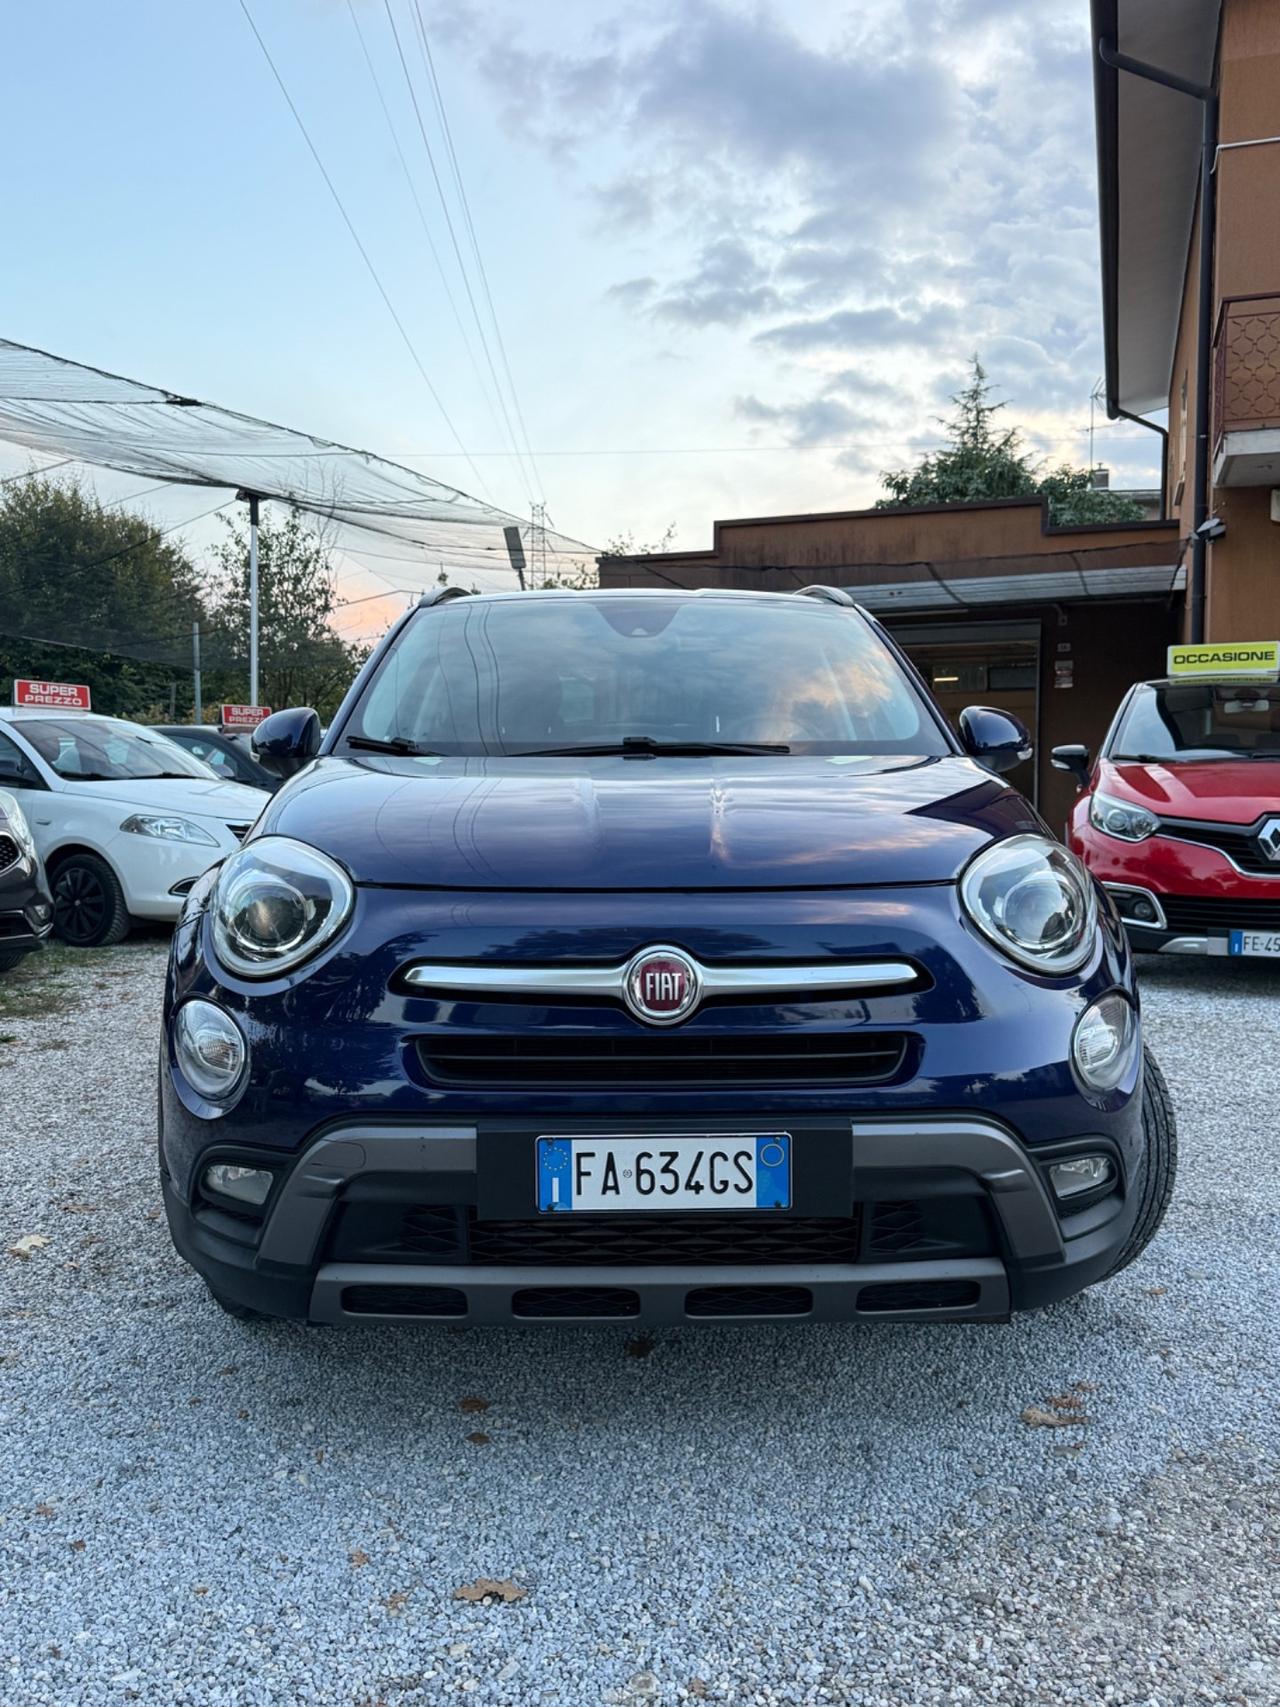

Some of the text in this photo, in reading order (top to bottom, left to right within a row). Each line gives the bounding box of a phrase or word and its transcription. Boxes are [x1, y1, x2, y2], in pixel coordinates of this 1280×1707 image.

[1173, 651, 1275, 665] OCCASIONE
[29, 684, 77, 697] SUPER
[24, 694, 82, 706] PREZZO
[231, 707, 264, 717] SUPER
[645, 972, 682, 1001] FIAT
